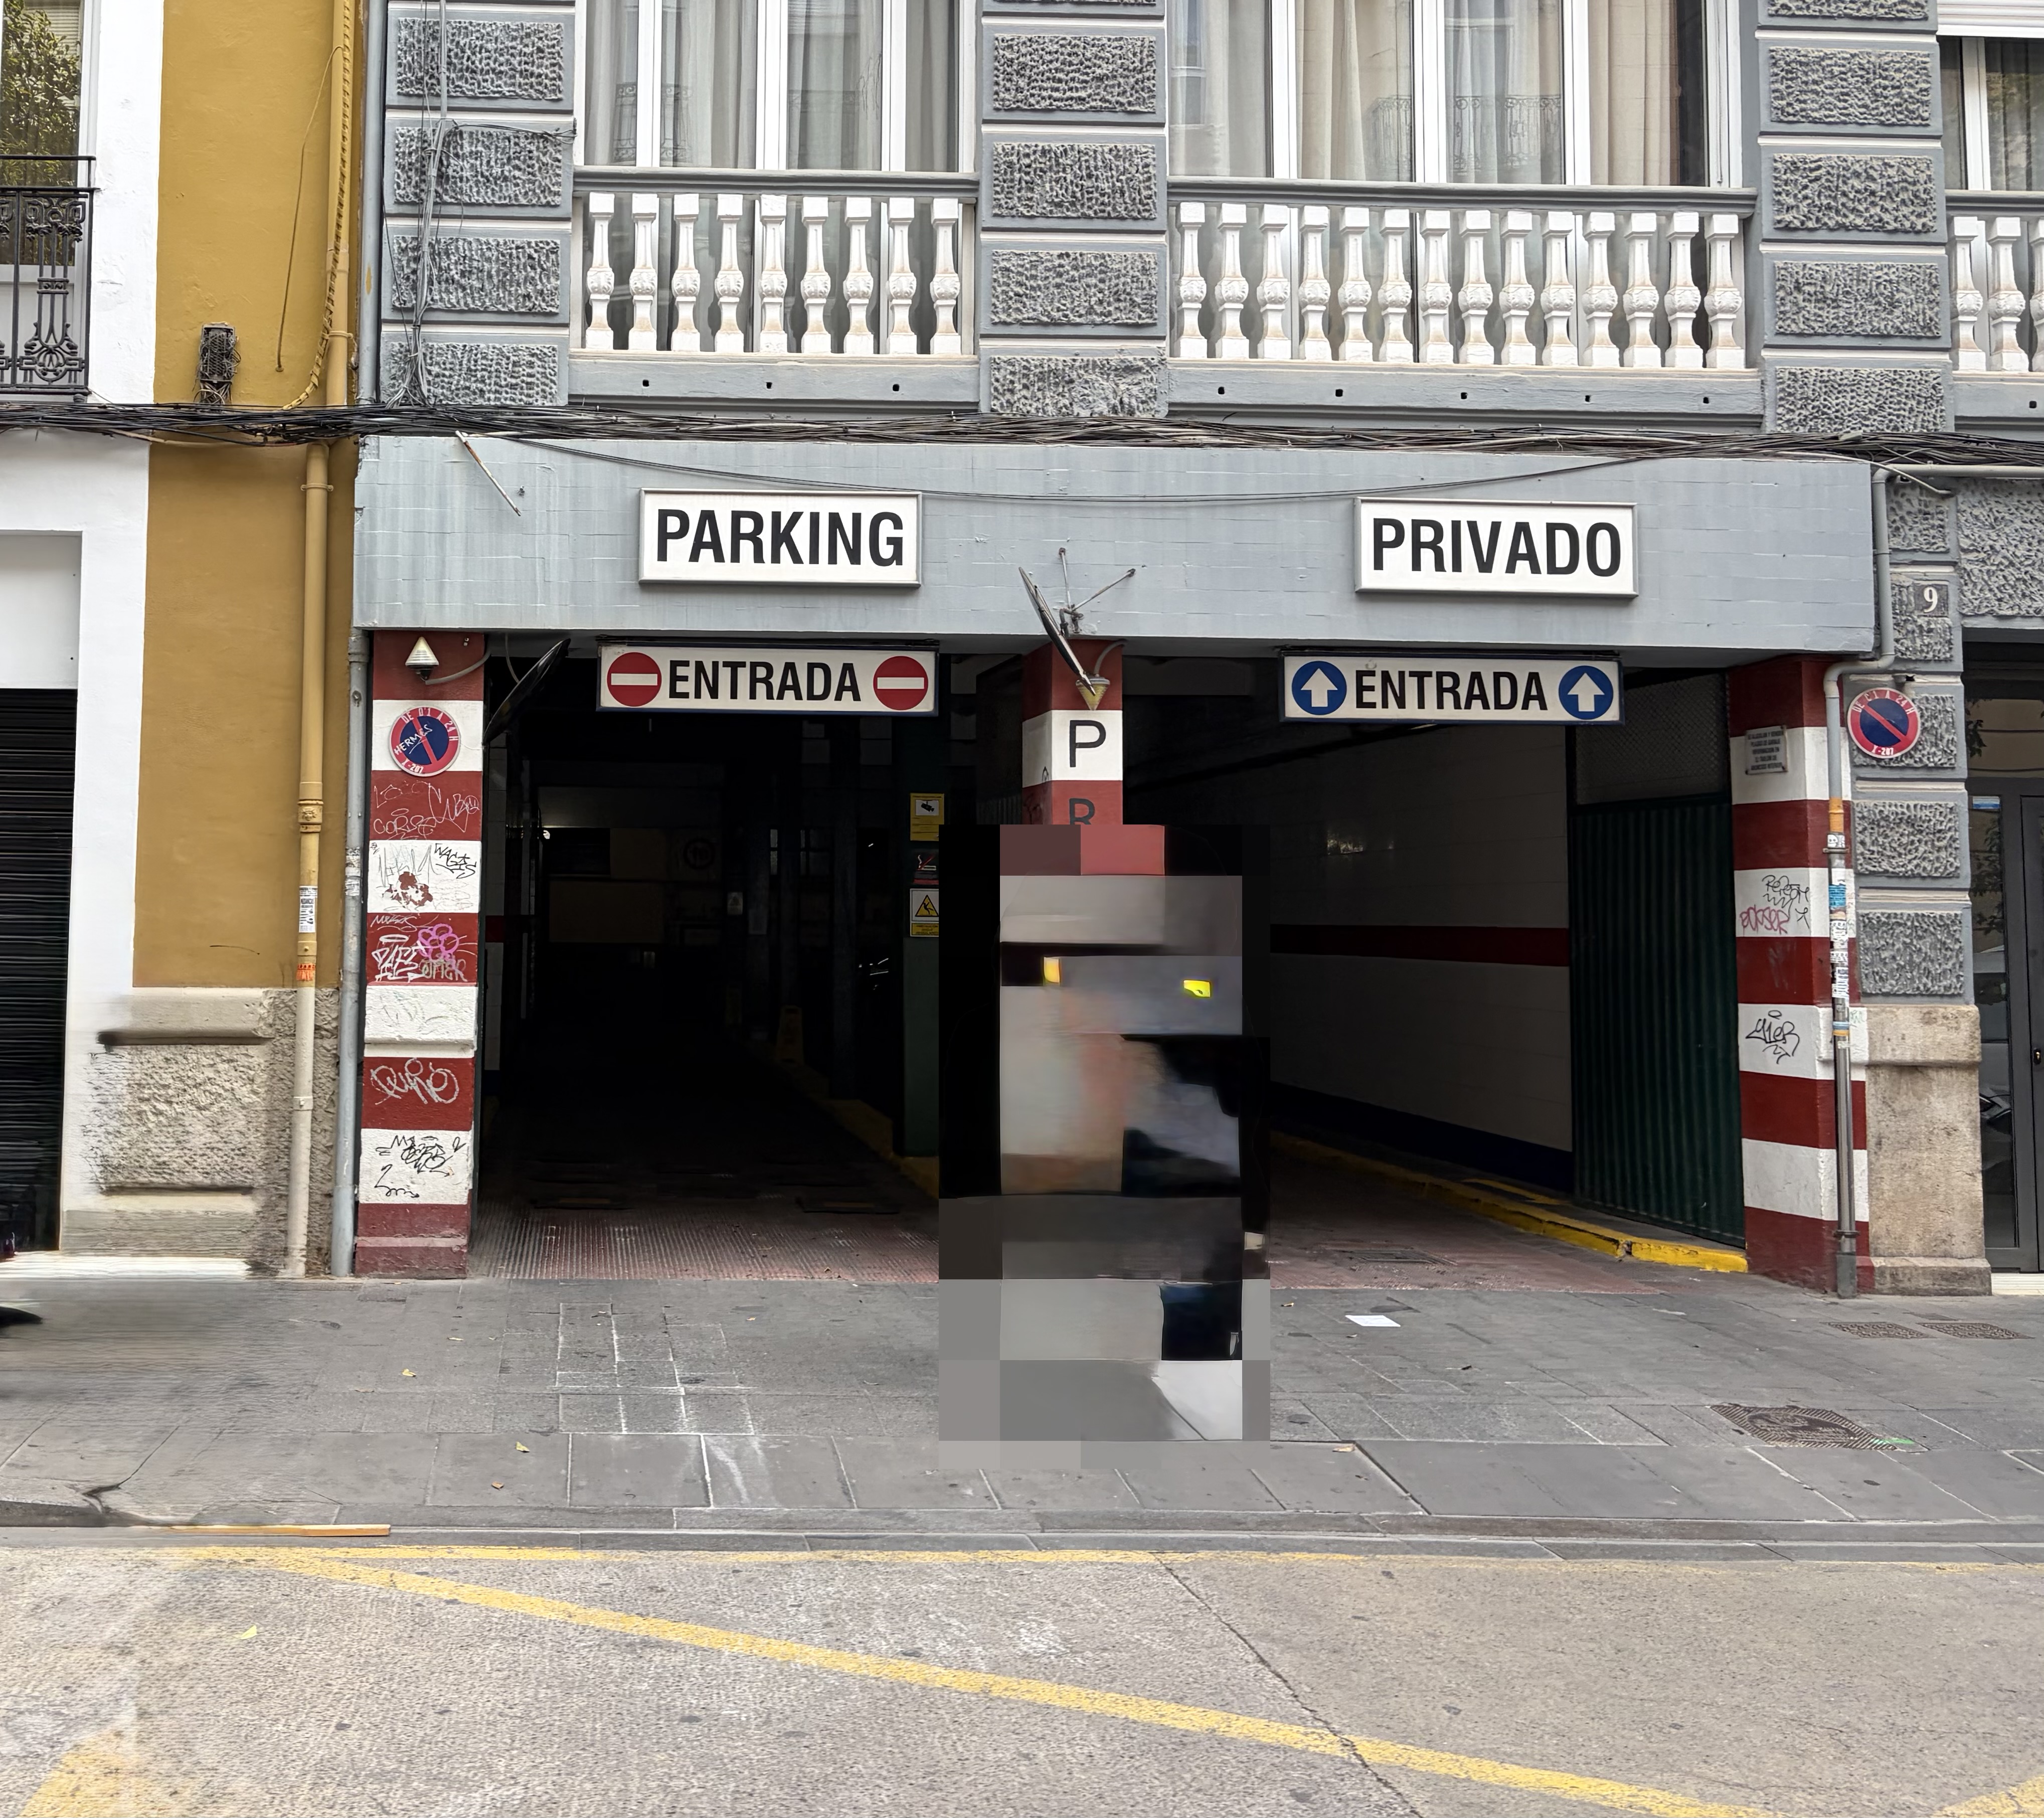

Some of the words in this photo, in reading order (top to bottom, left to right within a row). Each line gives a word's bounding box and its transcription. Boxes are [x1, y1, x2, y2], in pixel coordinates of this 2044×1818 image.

[657, 509, 903, 567] PARKING
[1373, 518, 1621, 577] PRIVADO
[1924, 586, 1938, 613] 9
[668, 659, 862, 702] ENTRADA
[1355, 670, 1548, 711] ENTRADA
[401, 711, 414, 724] DE
[436, 712, 444, 721] A
[1852, 701, 1865, 713] DE
[1896, 695, 1908, 707] 24
